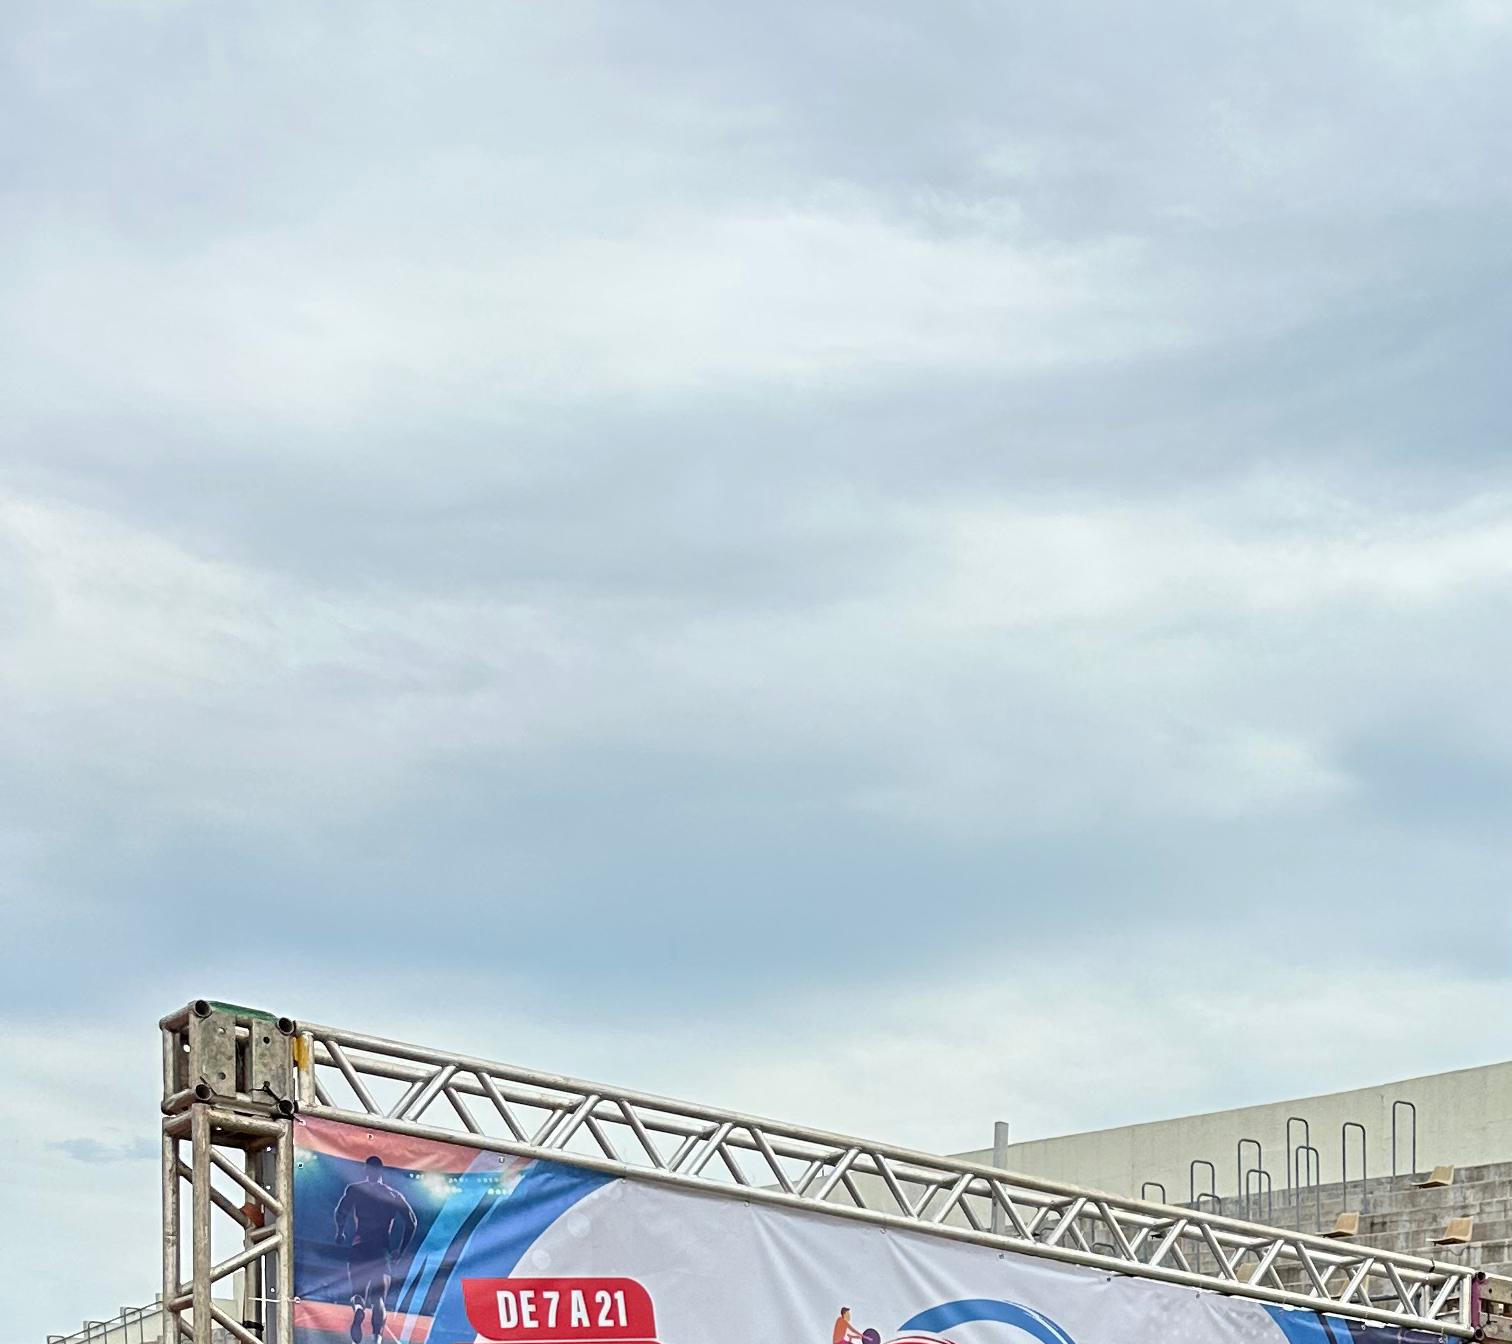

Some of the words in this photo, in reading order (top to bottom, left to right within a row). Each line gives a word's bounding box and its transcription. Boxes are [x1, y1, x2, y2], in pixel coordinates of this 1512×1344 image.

[496, 1290, 539, 1329] DE
[543, 1291, 560, 1328] 7
[570, 1289, 591, 1328] A
[595, 1290, 628, 1327] 21
